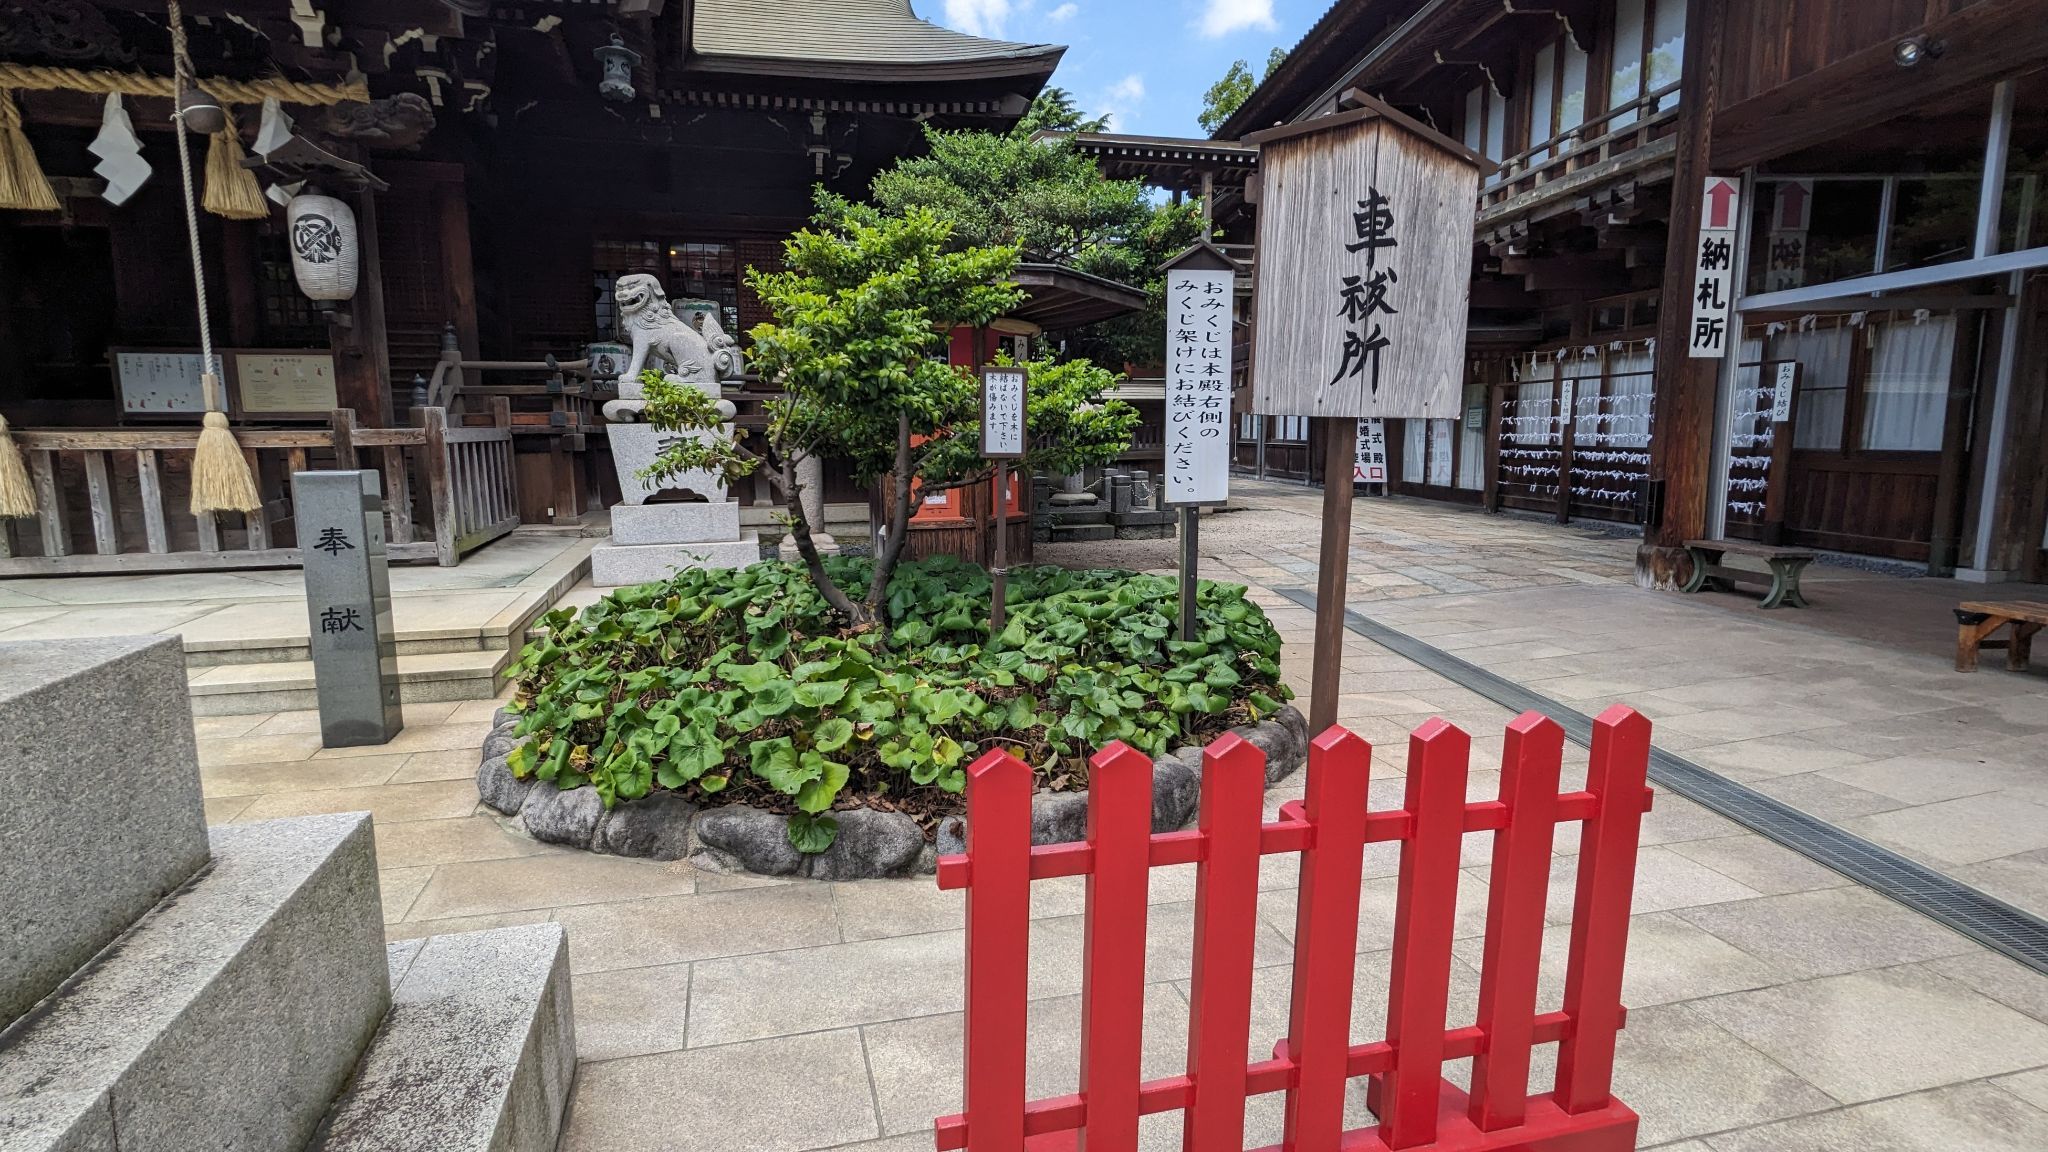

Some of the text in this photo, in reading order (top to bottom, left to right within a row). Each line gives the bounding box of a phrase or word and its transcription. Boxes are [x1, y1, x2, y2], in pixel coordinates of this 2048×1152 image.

[1330, 186, 1398, 394] 車祓所
[1693, 237, 1731, 348] 納札所
[989, 372, 998, 434] 木が傷みます。
[1172, 280, 1199, 493] みくじ架けにお結びください。
[1197, 281, 1225, 438] おみくじは本殿右側の
[1776, 366, 1790, 416] おみくじ結び
[999, 373, 1009, 452] 結ばないで下さい。
[1010, 373, 1019, 441] おみくじを木に
[1354, 466, 1383, 479] 入口
[313, 527, 364, 634] 奉献
